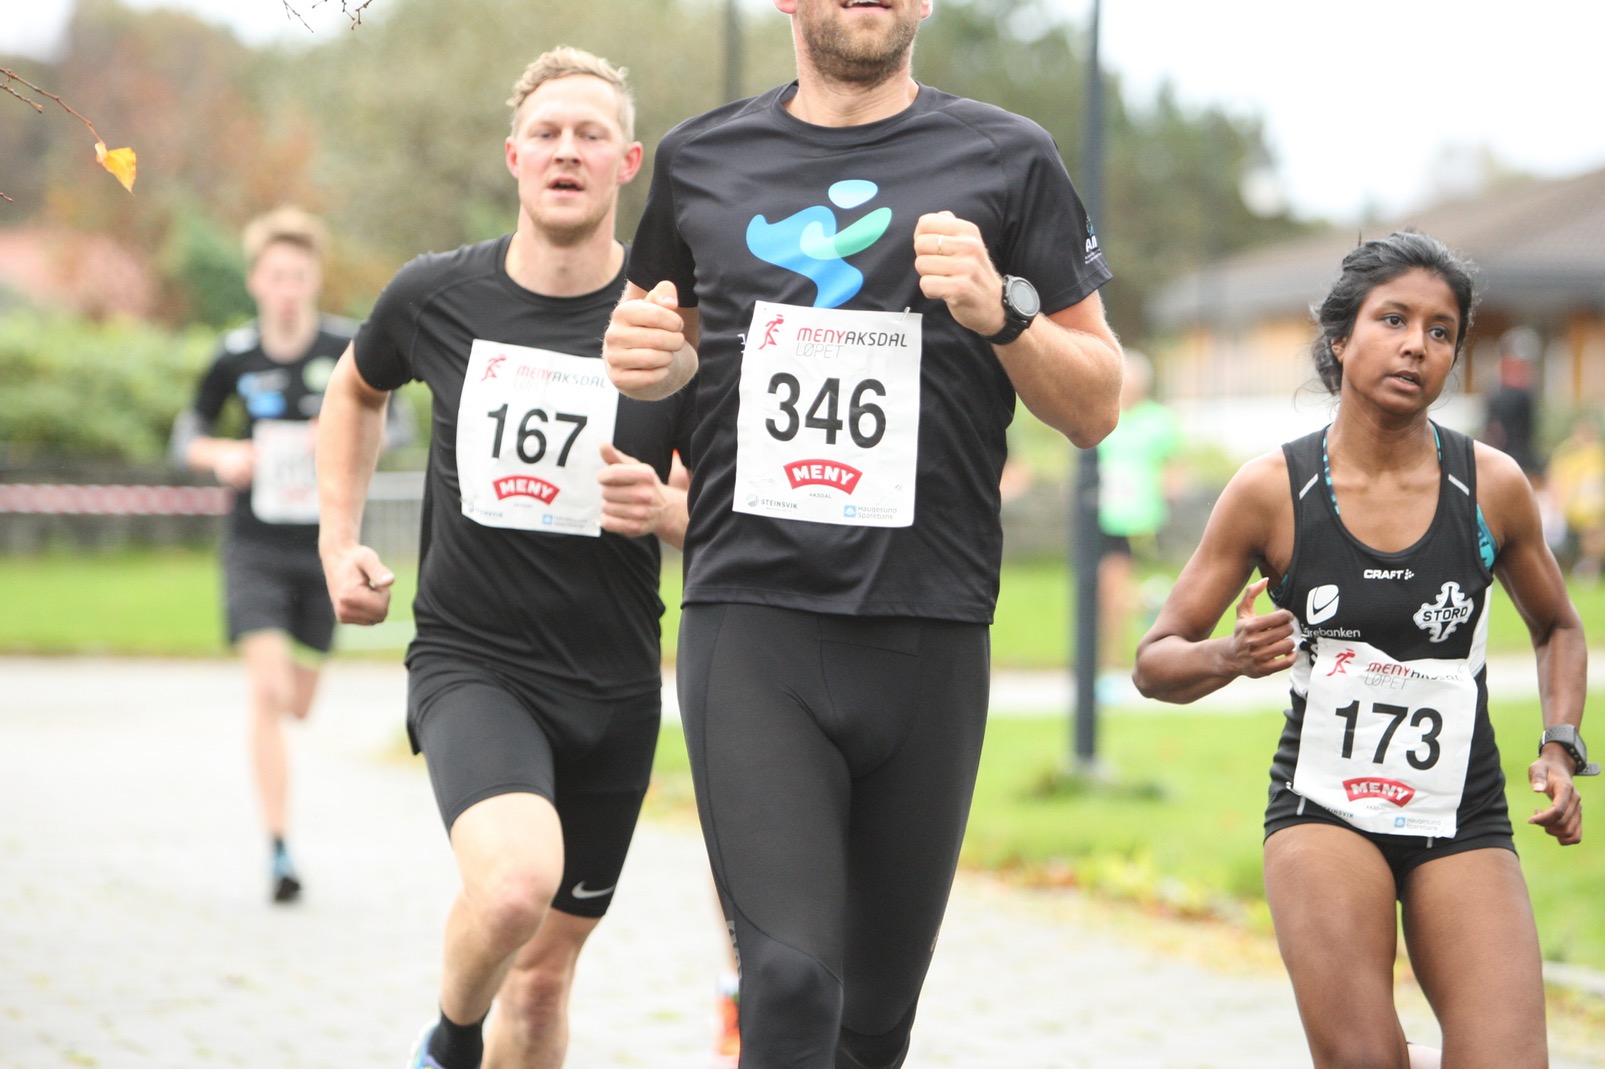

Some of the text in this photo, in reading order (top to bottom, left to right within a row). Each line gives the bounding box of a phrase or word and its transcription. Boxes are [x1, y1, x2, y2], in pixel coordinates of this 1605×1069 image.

[796, 327, 908, 348] MENYAKSDAL
[795, 343, 845, 359] LØPET
[765, 371, 887, 449] 346
[487, 403, 588, 468] 167
[791, 464, 855, 486] MENY
[499, 478, 554, 499] MENY
[761, 498, 798, 510] STEINSVIK
[1363, 569, 1404, 580] CRAFT
[1423, 606, 1469, 623] STORD
[1335, 699, 1443, 771] 173
[1350, 780, 1410, 802] MENY
